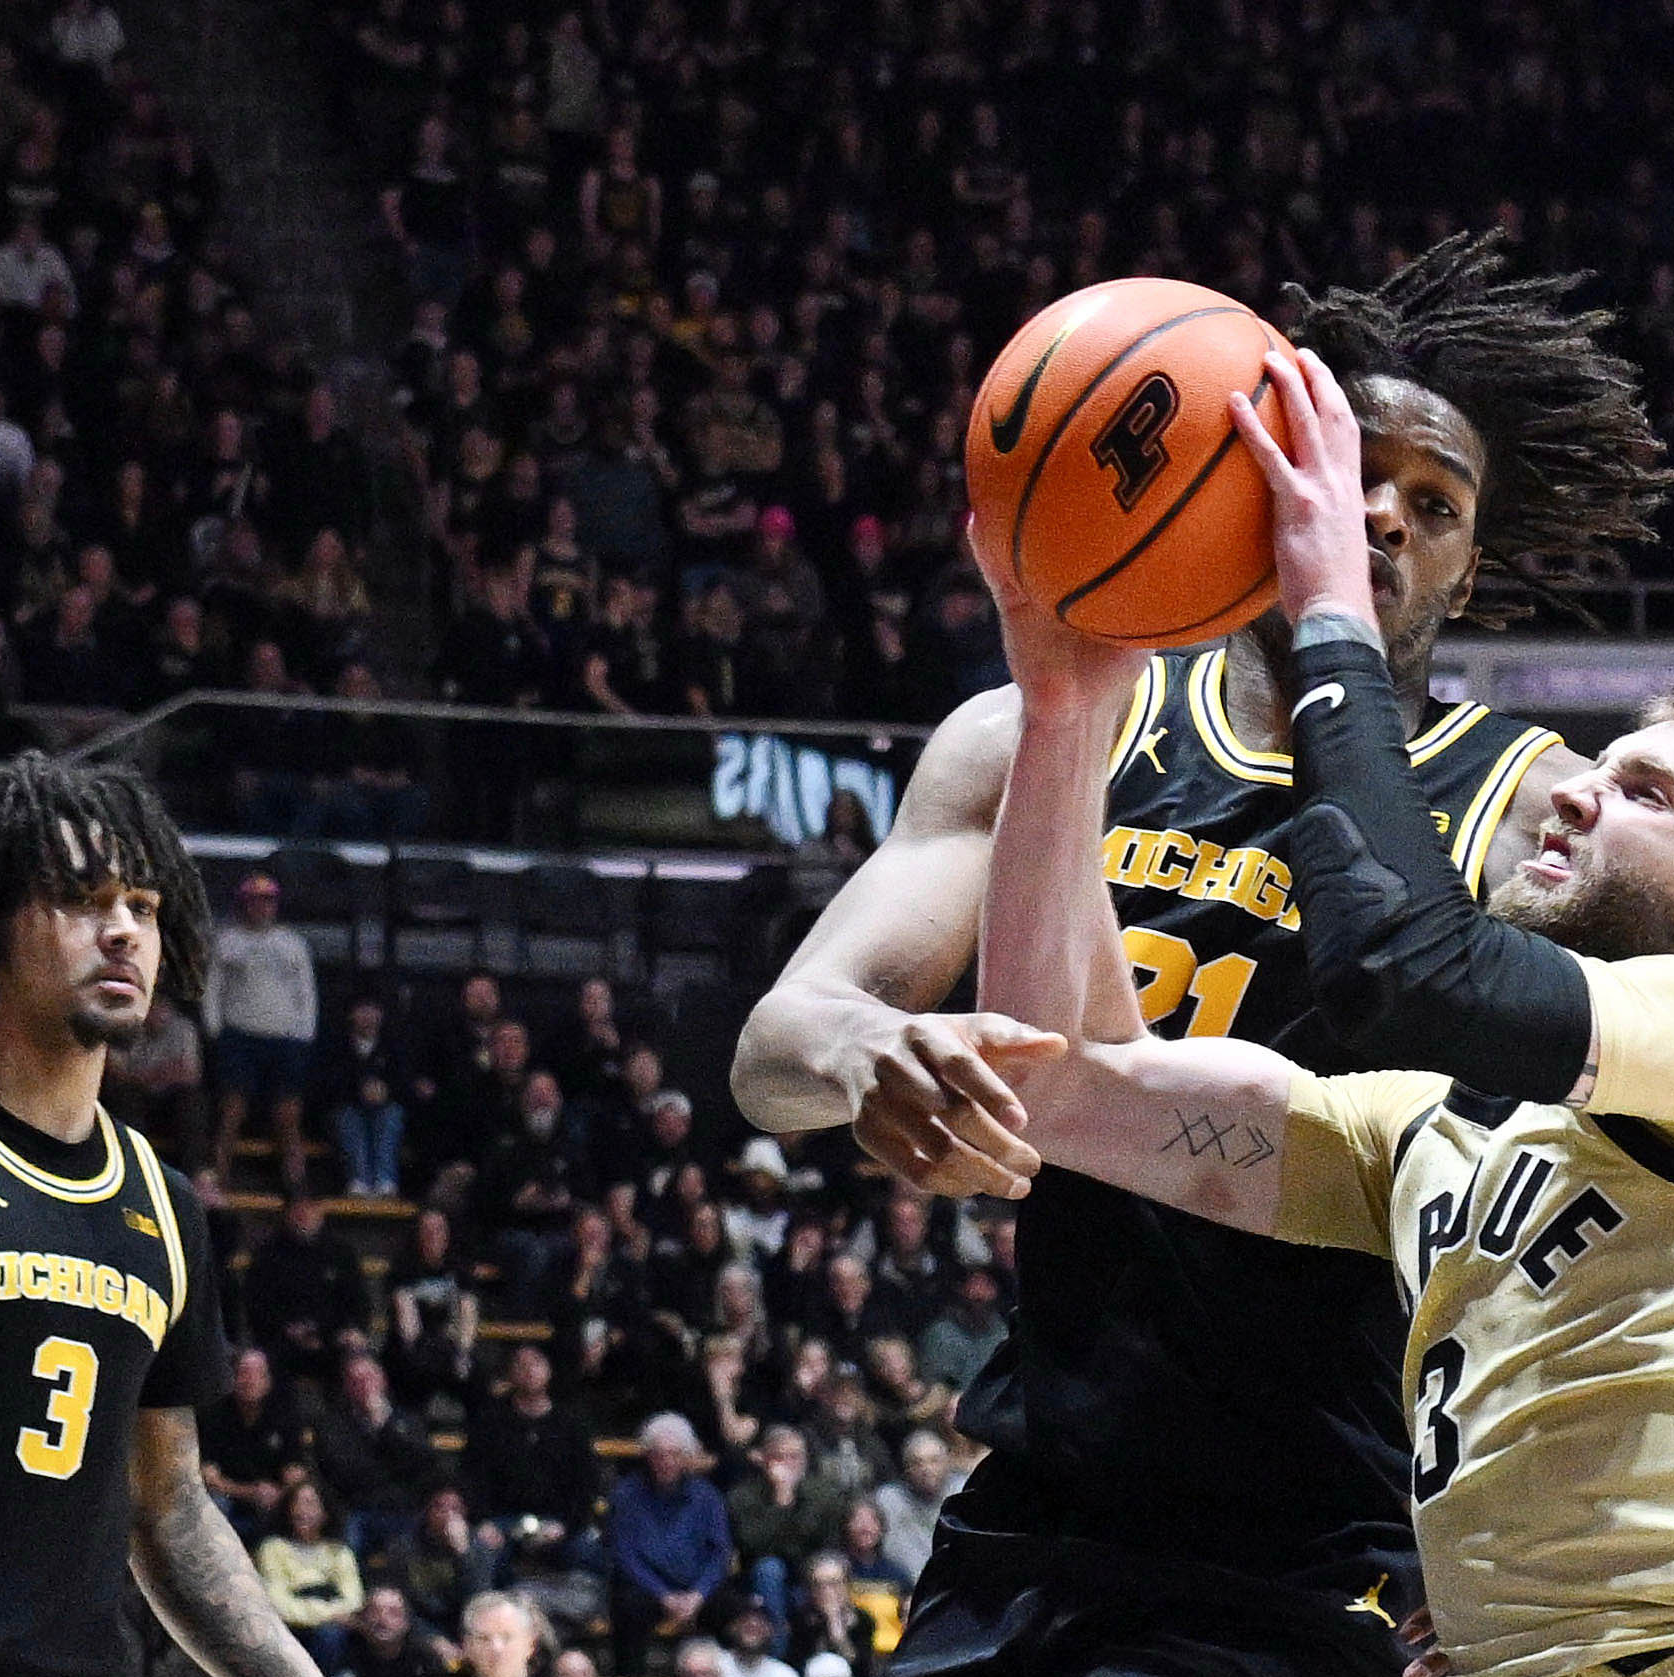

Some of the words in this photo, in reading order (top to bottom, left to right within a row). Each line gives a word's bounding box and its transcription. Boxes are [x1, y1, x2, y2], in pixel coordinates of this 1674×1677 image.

[1089, 371, 1180, 513] P
[1102, 825, 1301, 932] ICHIG
[16, 1336, 99, 1480] 3
